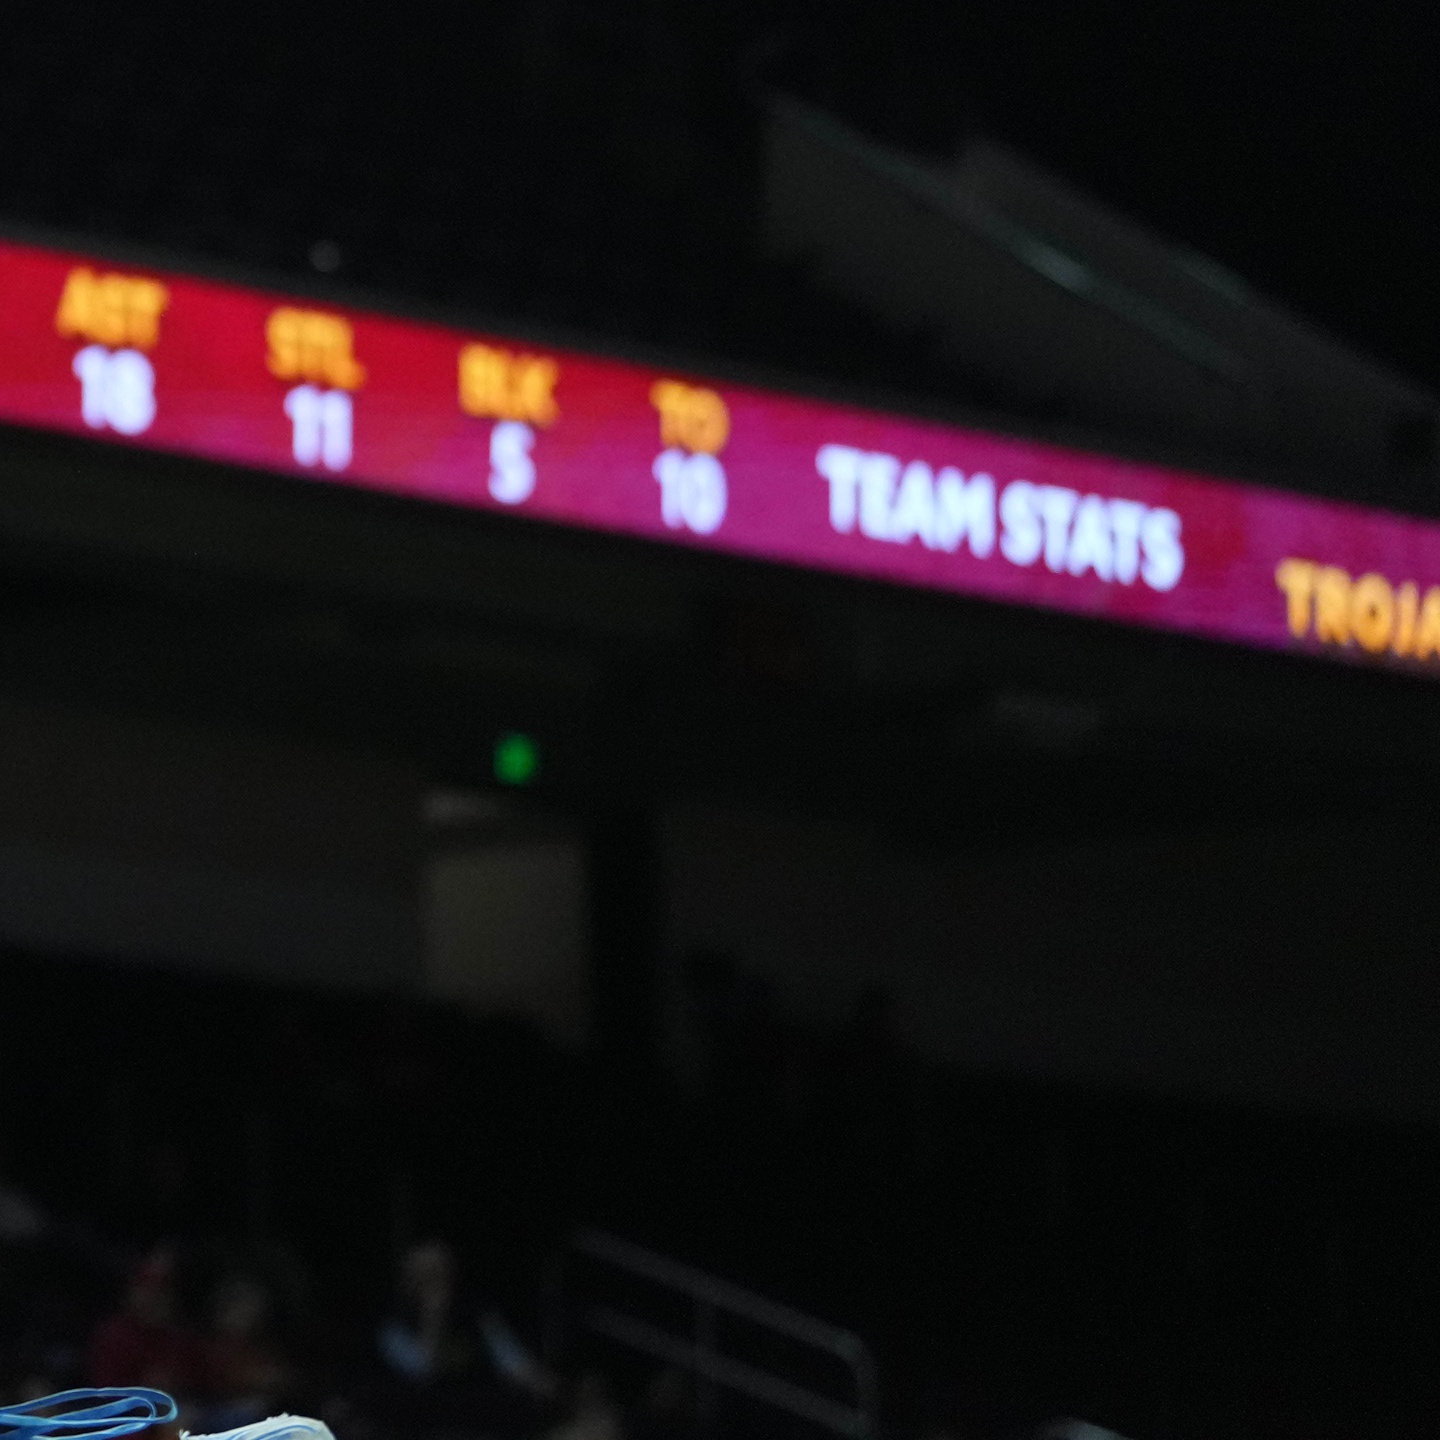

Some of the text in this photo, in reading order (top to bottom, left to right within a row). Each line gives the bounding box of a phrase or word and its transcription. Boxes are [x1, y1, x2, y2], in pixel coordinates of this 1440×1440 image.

[284, 383, 353, 470] 11
[815, 443, 1184, 592] TEAM STATS
